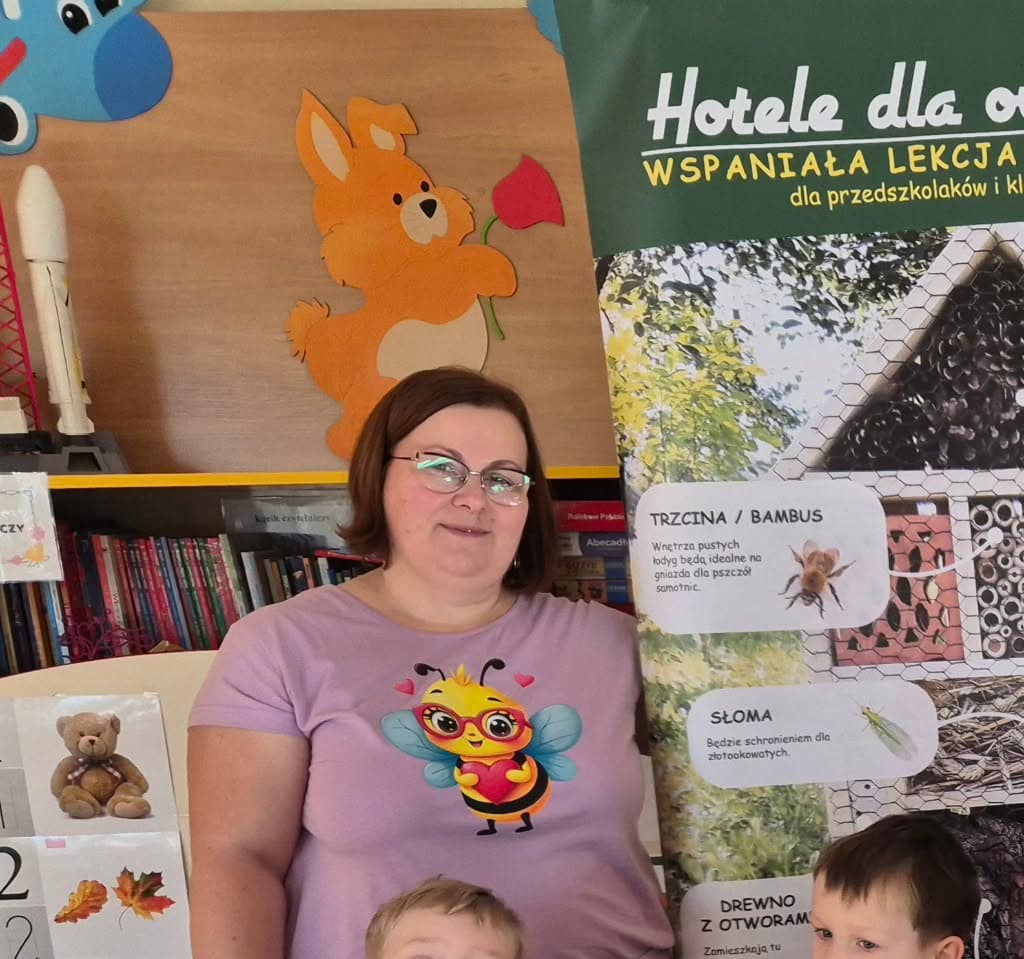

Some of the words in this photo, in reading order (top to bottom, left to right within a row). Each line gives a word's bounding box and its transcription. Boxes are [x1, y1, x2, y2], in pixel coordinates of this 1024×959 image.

[647, 65, 842, 144] Hotele
[868, 61, 962, 129] dla
[642, 152, 868, 187] WSPANIAŁA
[887, 142, 1017, 174] LEKCJA
[790, 184, 821, 207] dla
[827, 176, 987, 210] przedszkolaków
[994, 177, 1001, 197] i
[650, 511, 728, 527] TRZCINA
[751, 508, 824, 525] BAMBUS
[652, 541, 695, 553] Wnętrza
[698, 539, 740, 551] pustych
[680, 554, 706, 566] będą
[709, 553, 746, 564] idealne
[749, 554, 761, 563] na
[655, 568, 691, 581] gniazda
[693, 567, 709, 578] dla
[713, 566, 752, 579] pszczół
[710, 708, 773, 725] SŁOMA
[707, 738, 742, 749] Będzie
[744, 733, 812, 747] schronieniem
[815, 732, 831, 742] dla
[0, 846, 30, 900] 2
[721, 894, 796, 913] DREWNO
[701, 919, 713, 933] Z
[719, 911, 812, 932] OTWORAM
[703, 945, 768, 957] Zamieszkają
[770, 944, 782, 952] tu
